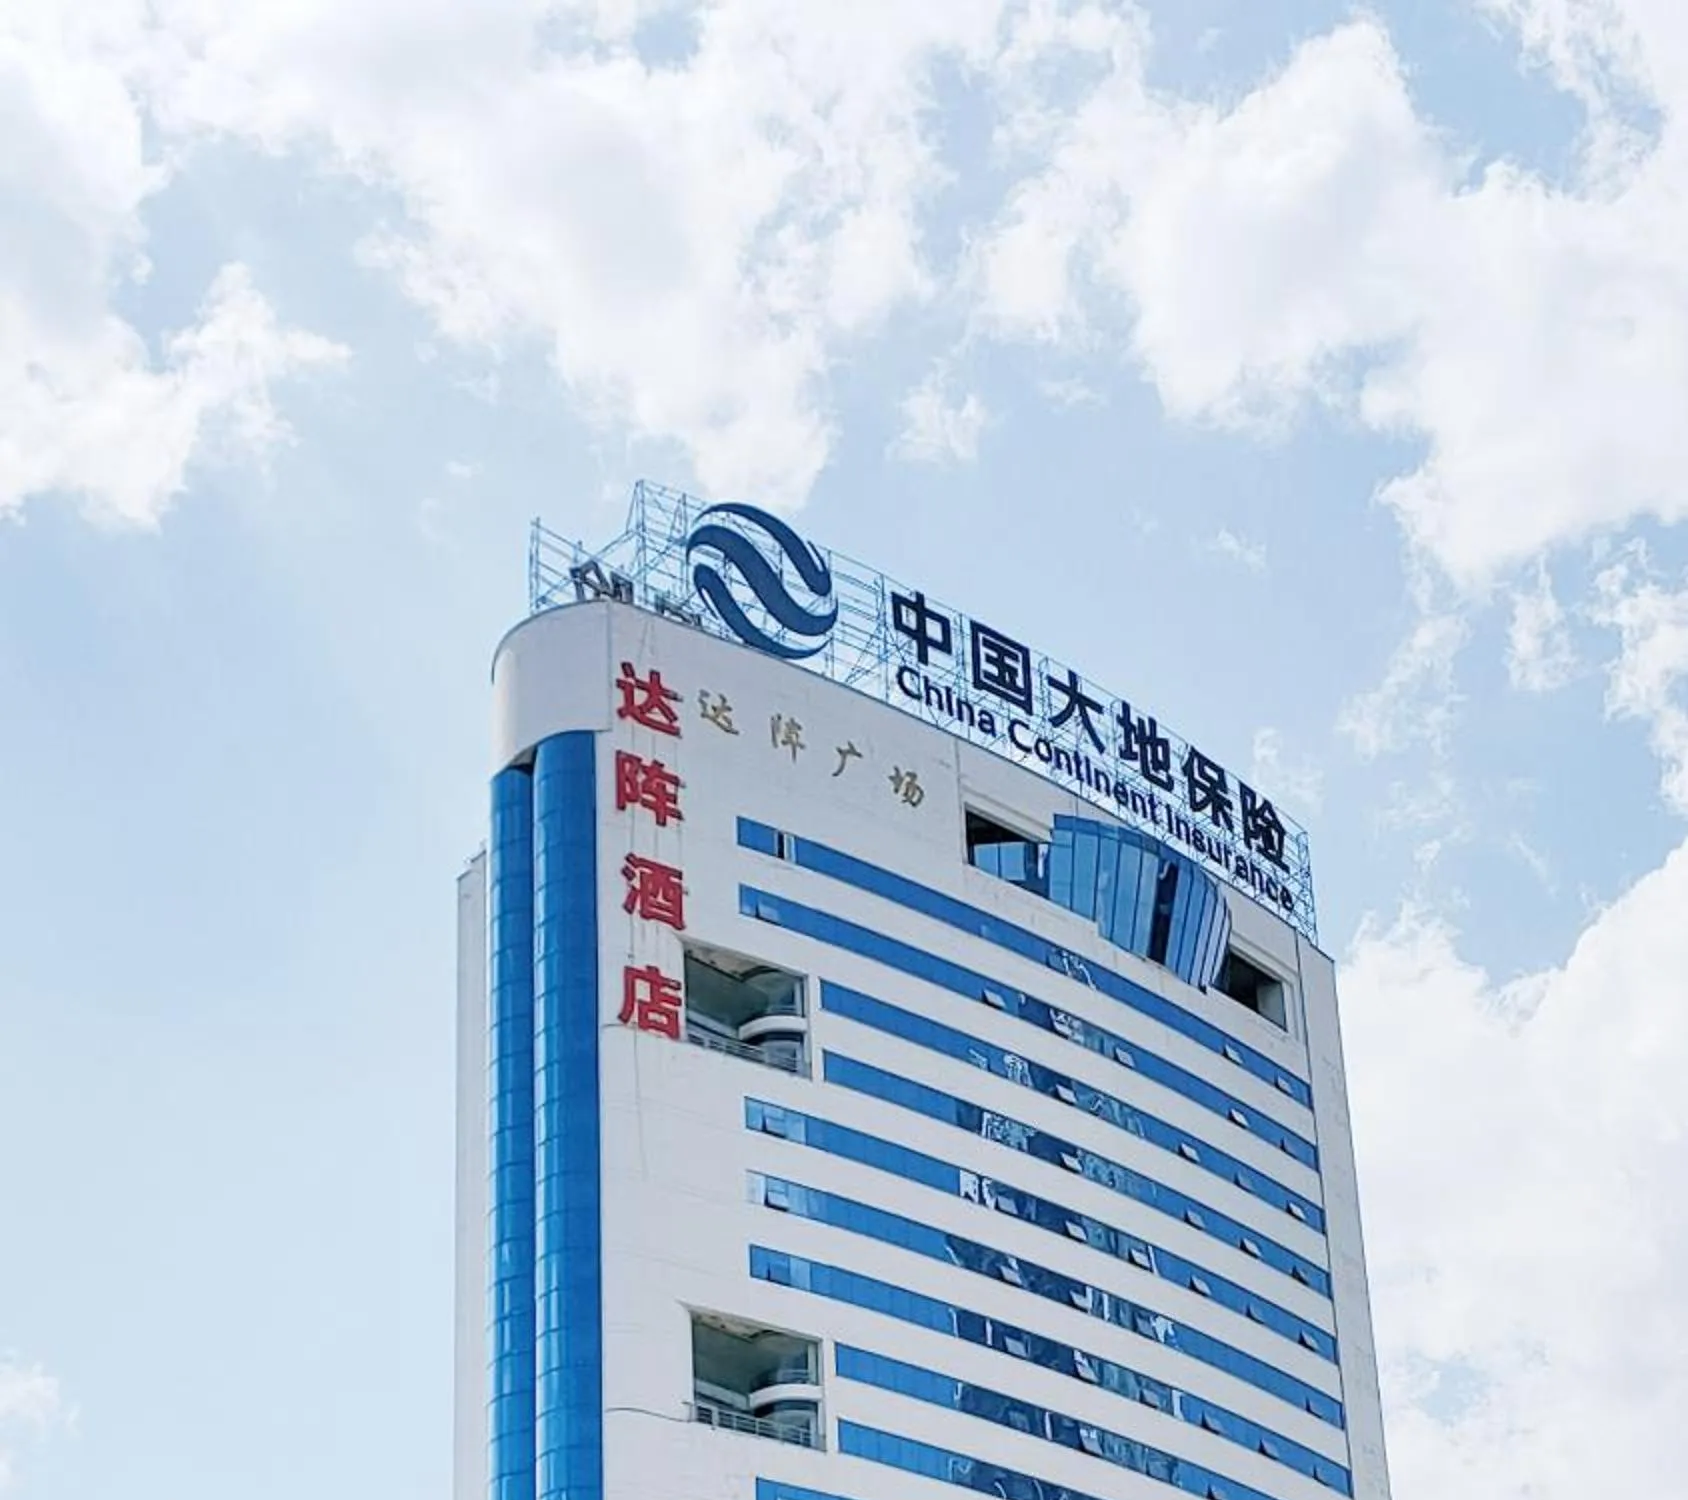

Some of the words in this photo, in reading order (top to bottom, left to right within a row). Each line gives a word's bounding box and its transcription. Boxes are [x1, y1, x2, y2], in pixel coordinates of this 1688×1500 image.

[615, 661, 685, 1041] 达阵酒店
[698, 688, 925, 807] 达阵广场
[891, 590, 1290, 873] 中国大地保险
[896, 665, 997, 738] China
[1008, 719, 1159, 825] Continent
[1165, 803, 1294, 911] Insurance
